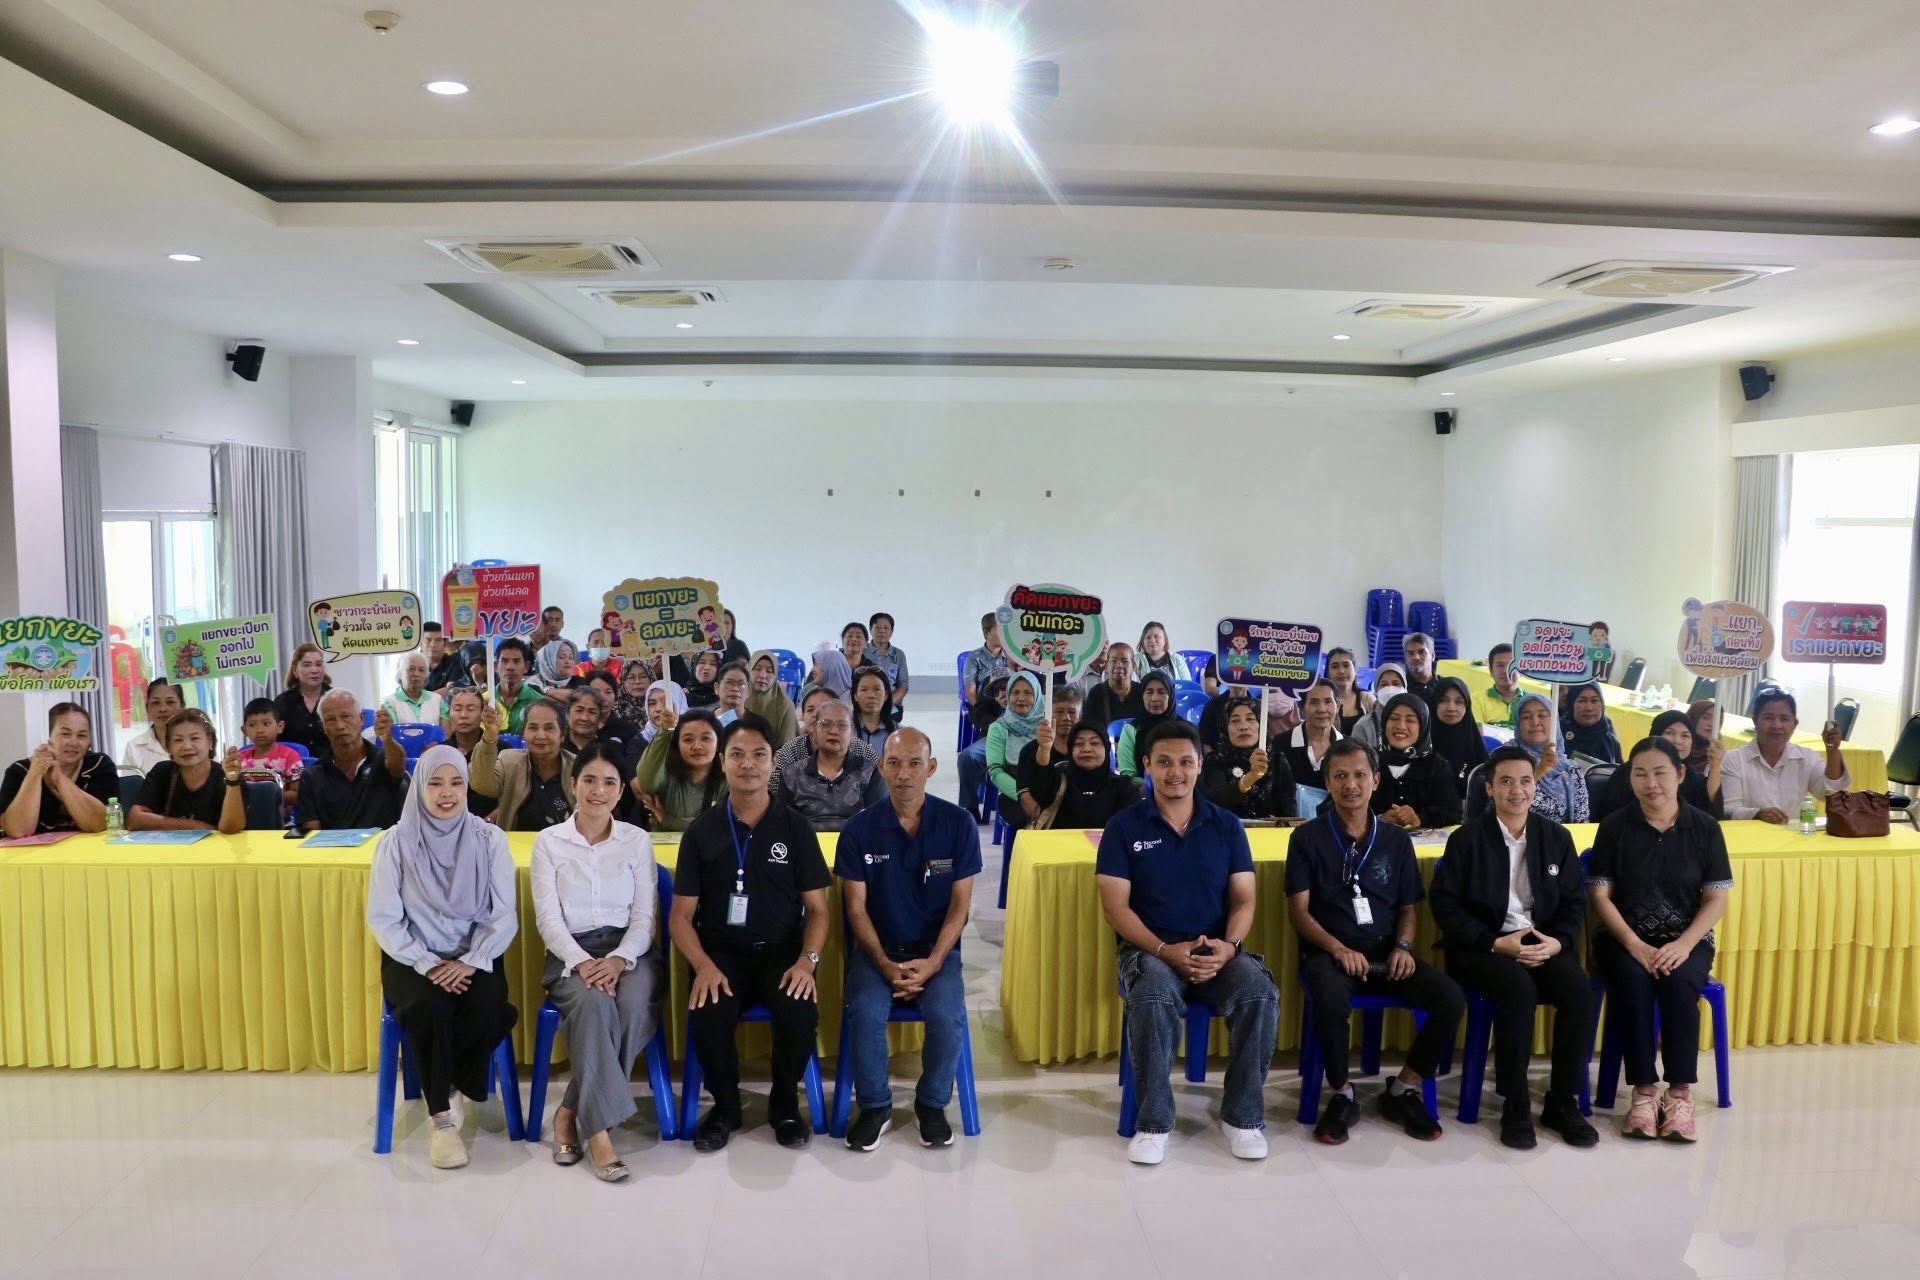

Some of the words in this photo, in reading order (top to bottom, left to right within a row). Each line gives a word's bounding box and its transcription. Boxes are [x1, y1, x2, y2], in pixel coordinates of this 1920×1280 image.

[482, 568, 535, 582] ช่วยกันแยก
[483, 584, 529, 597] ช่วยกันลด
[634, 588, 697, 608] แยกขยะ
[1012, 586, 1100, 613] คัดแยกขยะ
[342, 618, 372, 632] ร่วมใจ
[376, 621, 391, 630] ลด
[480, 609, 537, 637] ขยะ
[1022, 608, 1082, 631] กันเถอะ
[201, 621, 269, 640] แยกขยะเปียก
[641, 620, 696, 639] ลดขยะ
[1534, 626, 1572, 637] ลดขยะ
[220, 637, 255, 653] ออกไป
[342, 636, 400, 648] คัดแยกขยะ
[1522, 637, 1583, 655] ลดโลกร้อน
[1726, 631, 1760, 649] ก่อนทิ้ง
[1789, 639, 1883, 657] เราแยกขยะ
[215, 654, 262, 670] ไม่เทรวม
[49, 670, 97, 690] เพื่อเรา
[1252, 664, 1310, 679] คัดแยกขยะ
